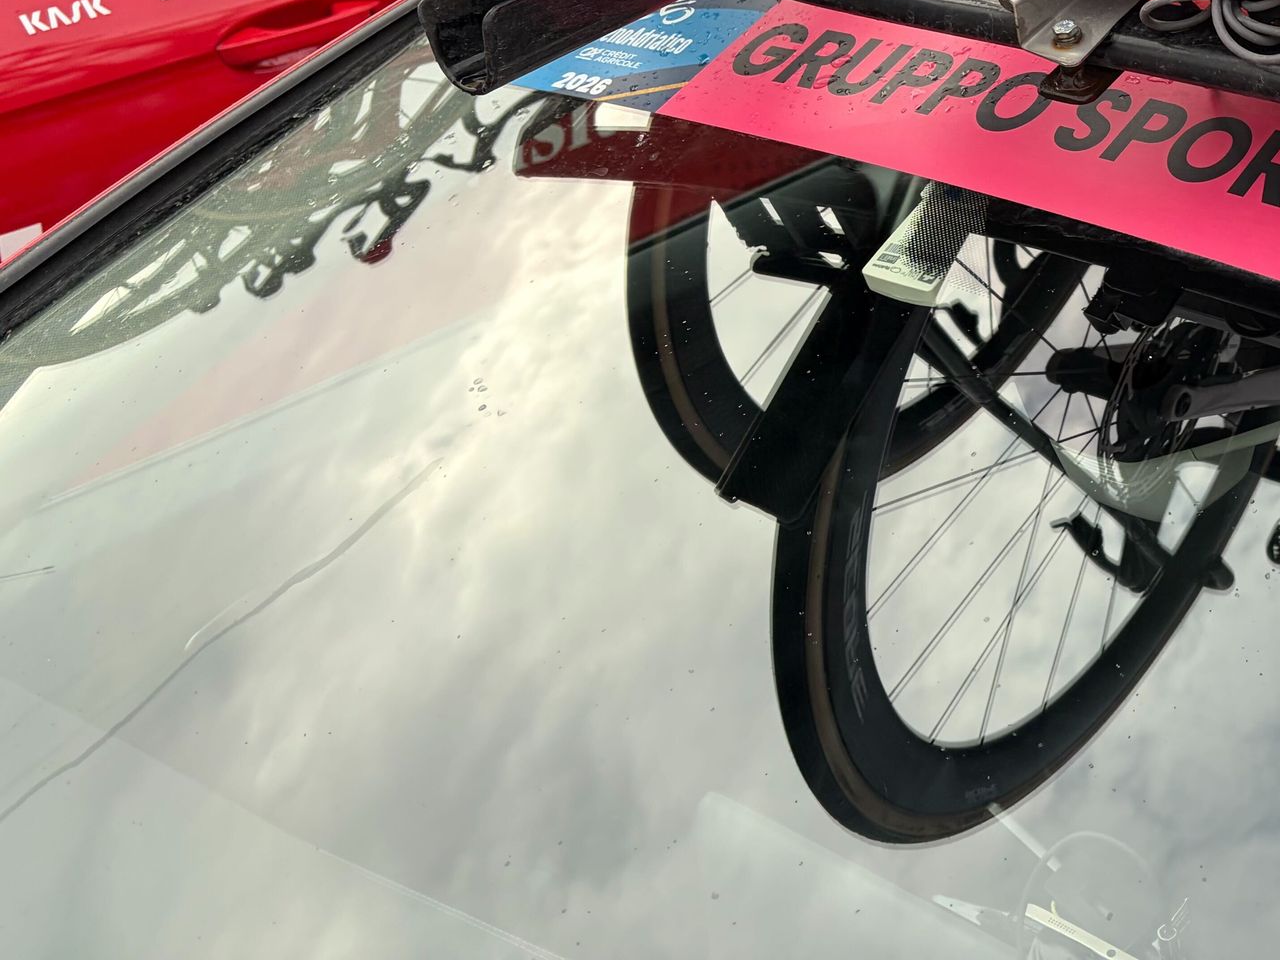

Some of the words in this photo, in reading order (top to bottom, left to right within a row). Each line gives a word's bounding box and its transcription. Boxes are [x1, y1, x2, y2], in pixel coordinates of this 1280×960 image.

[593, 55, 643, 69] AGRICOLE
[602, 48, 638, 61] CRÉDIT
[550, 71, 614, 96] 2026
[732, 22, 1050, 134] GRUPPO
